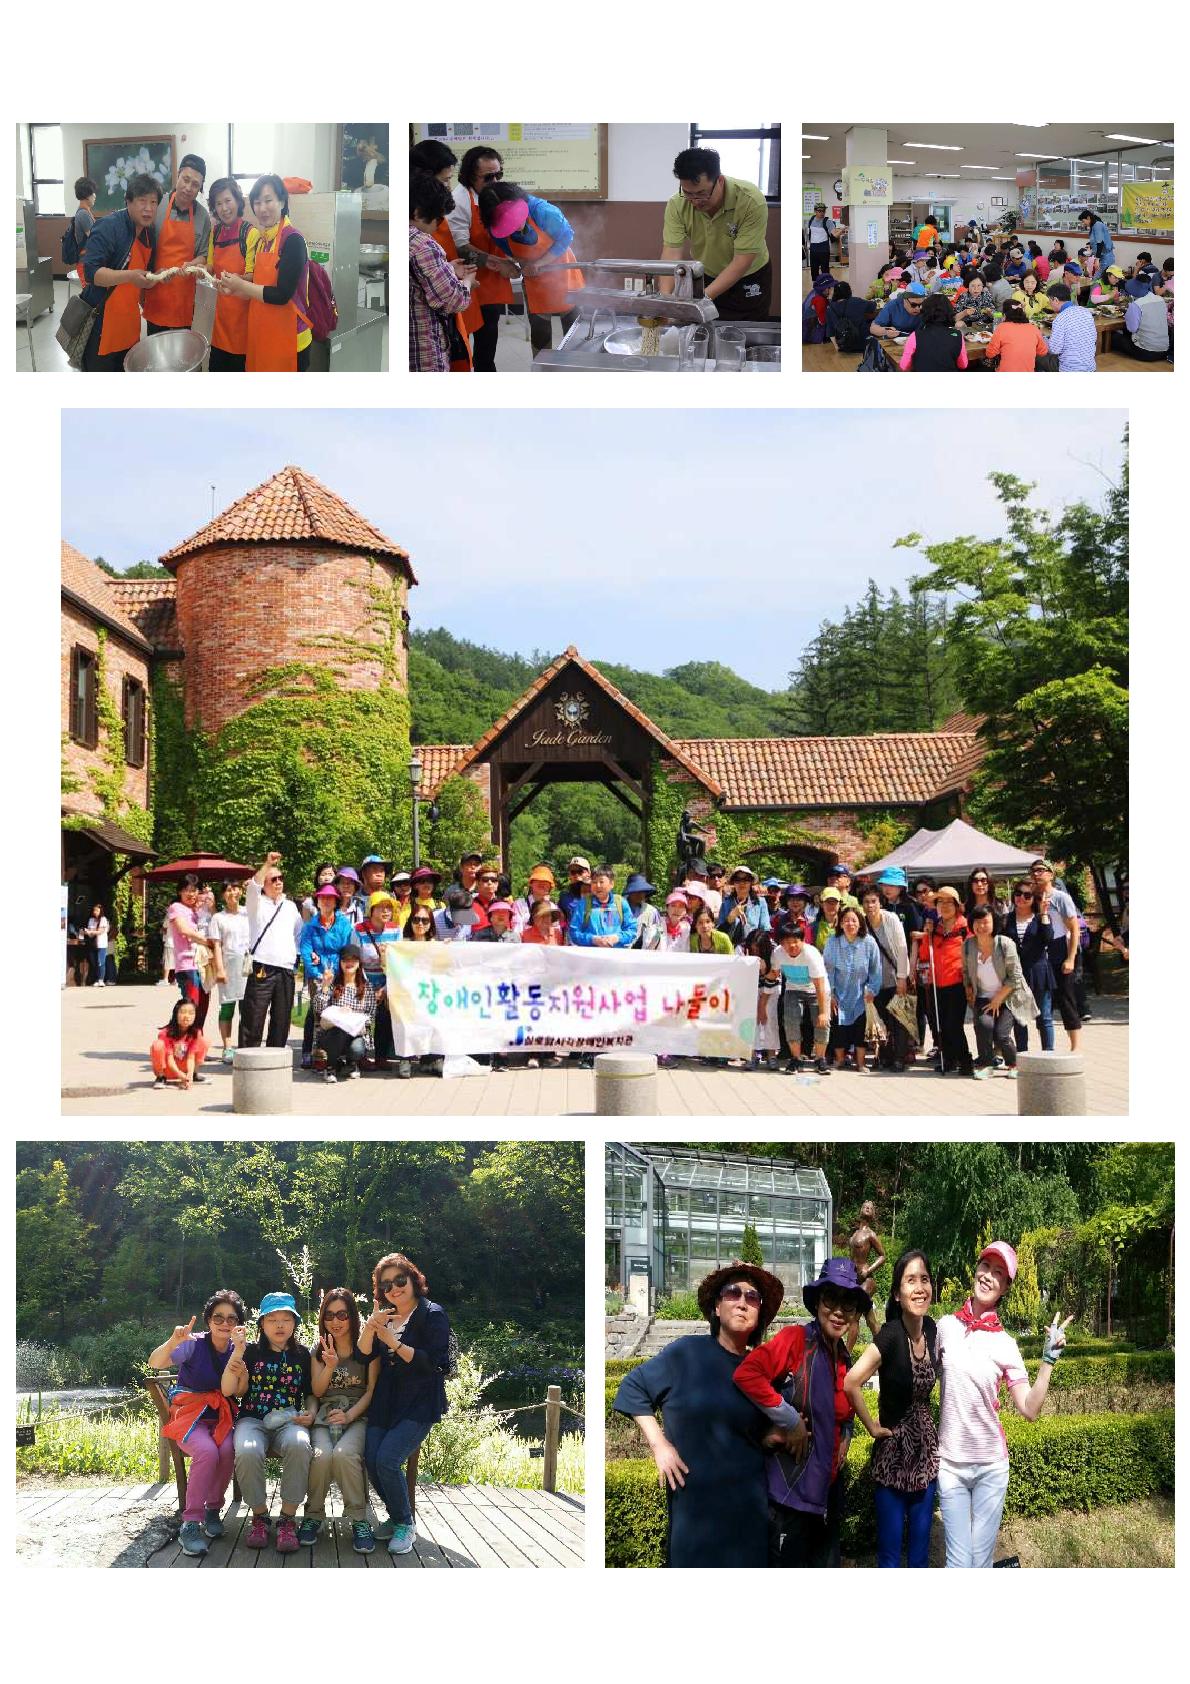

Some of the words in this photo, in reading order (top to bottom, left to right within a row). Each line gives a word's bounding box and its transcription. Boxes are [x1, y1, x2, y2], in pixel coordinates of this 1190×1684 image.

[525, 729, 564, 748] Jade
[566, 729, 612, 747] Garden
[418, 978, 648, 1022] 장애인활동지원사업
